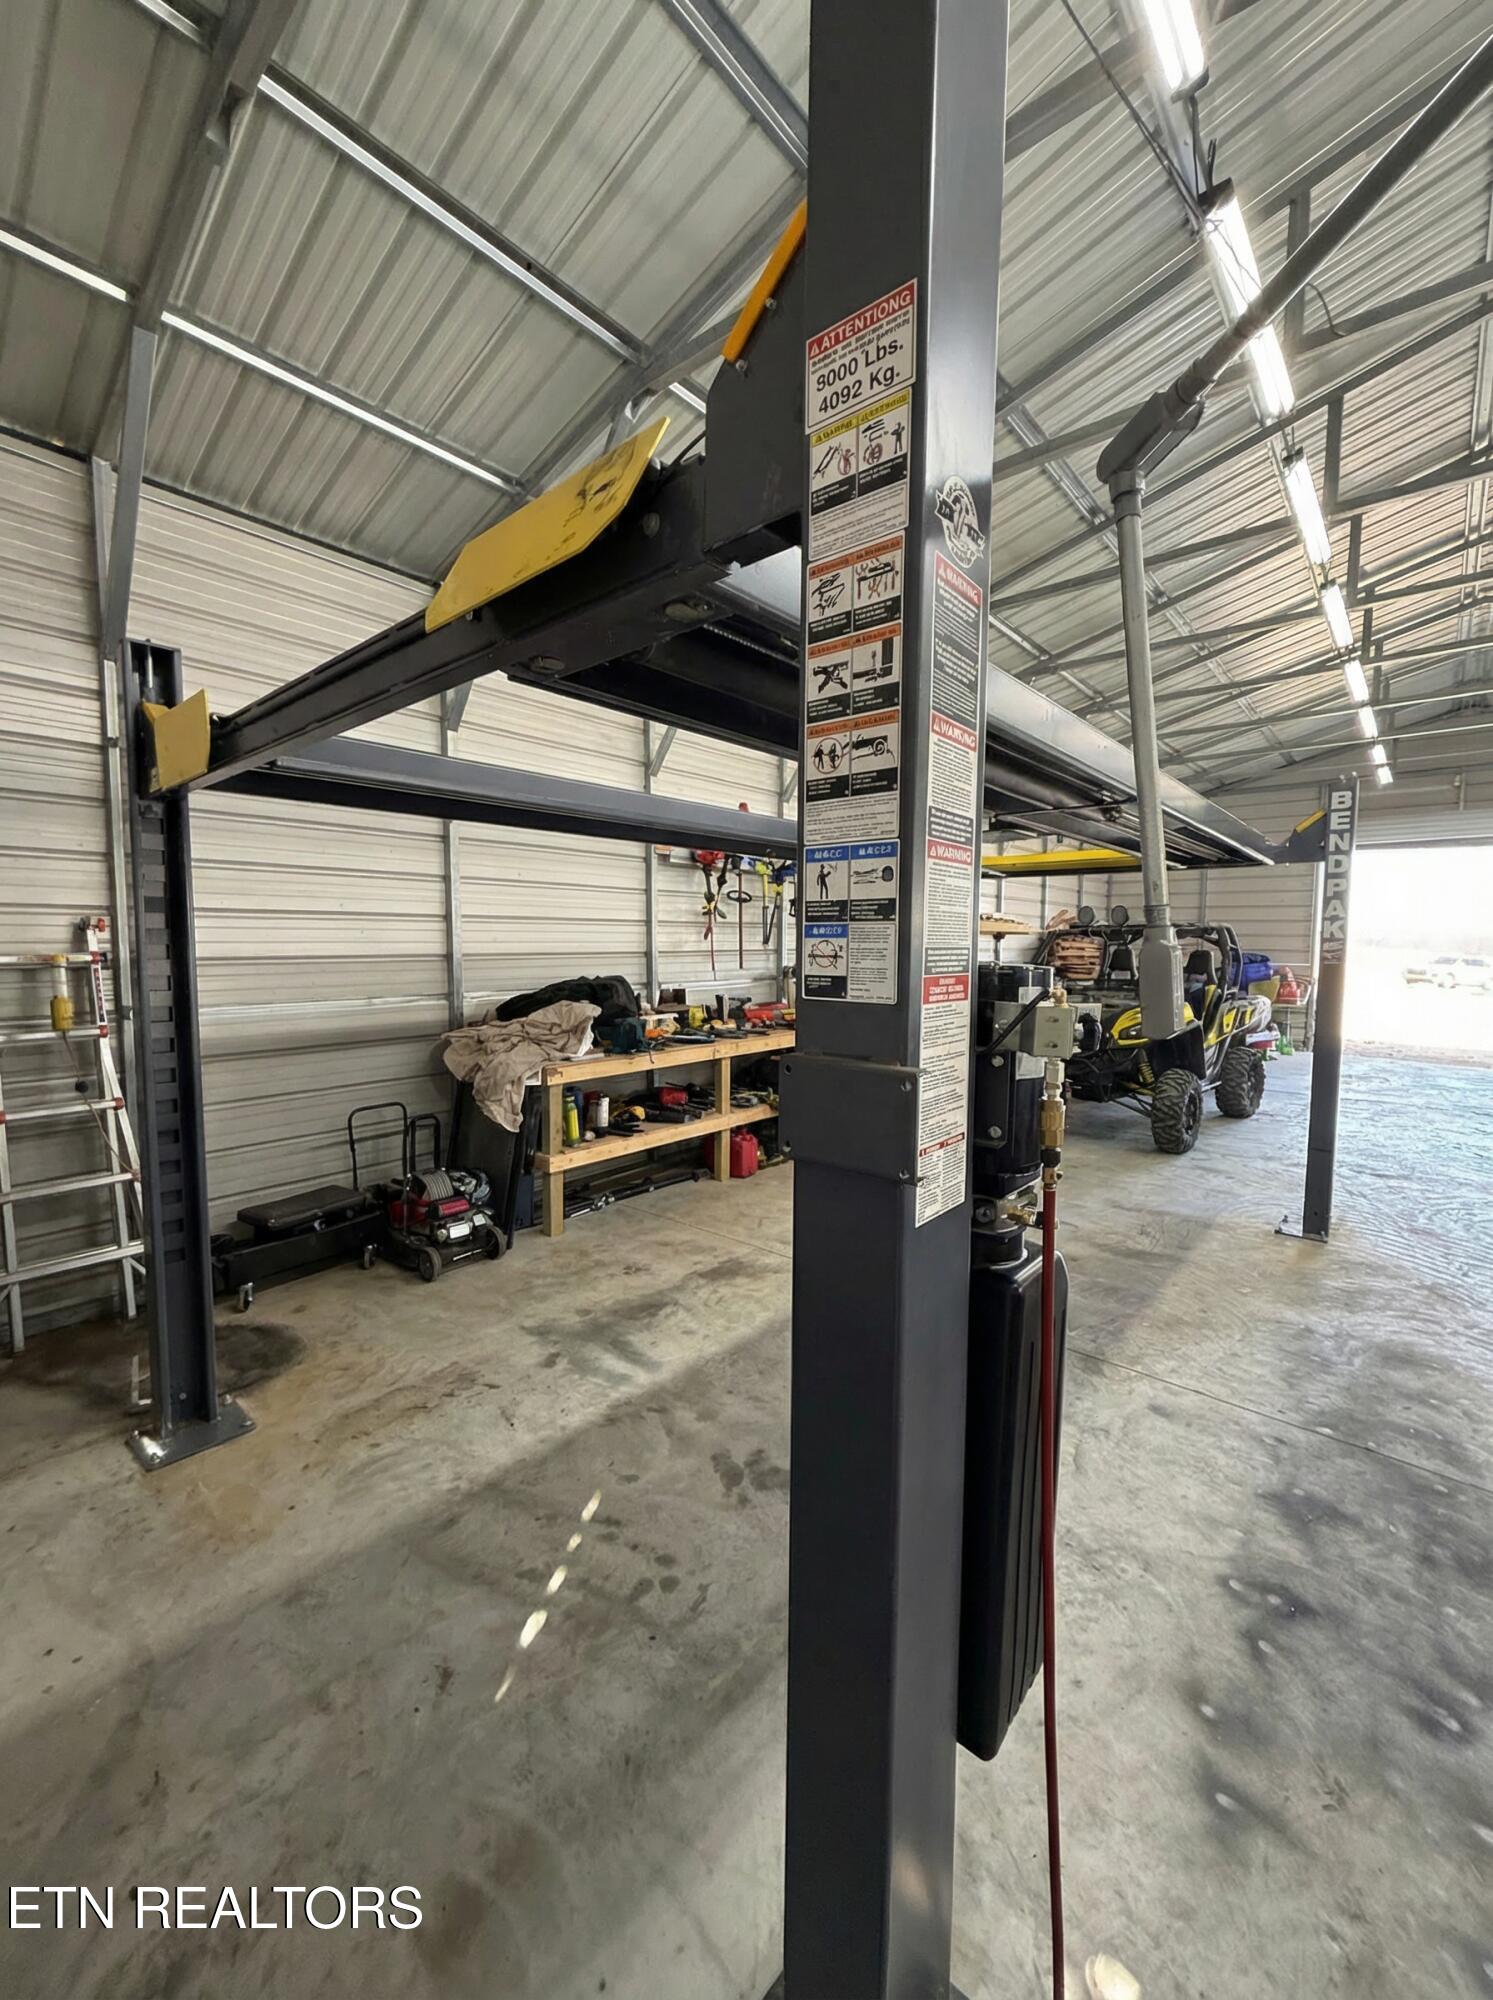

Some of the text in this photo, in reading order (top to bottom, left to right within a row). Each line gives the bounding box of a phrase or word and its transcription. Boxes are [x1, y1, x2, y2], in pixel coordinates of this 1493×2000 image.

[864, 339, 904, 368] Lbs.
[819, 379, 863, 414] 4092
[869, 365, 900, 391] Kg.
[1323, 790, 1352, 938] BENDPAK
